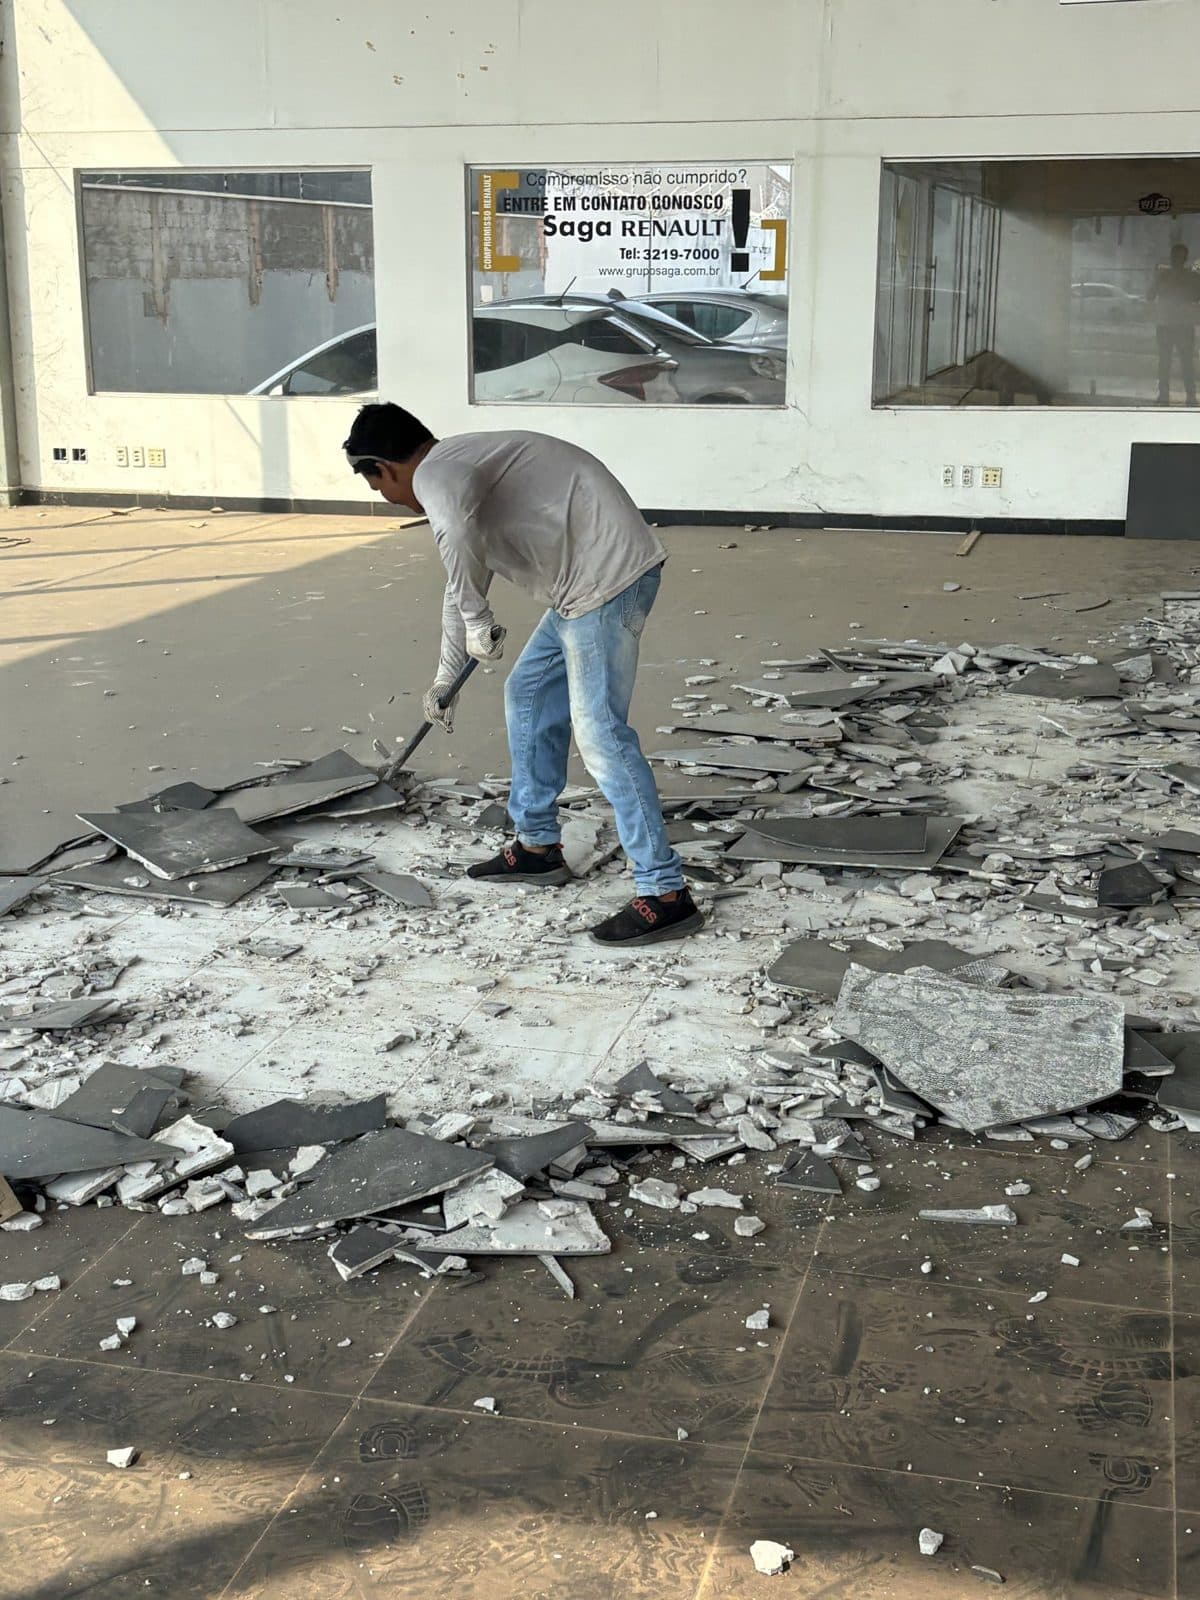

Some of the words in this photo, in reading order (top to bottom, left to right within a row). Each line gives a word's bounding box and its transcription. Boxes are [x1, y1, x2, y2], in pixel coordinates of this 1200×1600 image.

[526, 171, 629, 187] Compromisso
[634, 171, 661, 185] não
[667, 169, 747, 186] cumprido?
[483, 174, 492, 209] RENAULT
[503, 196, 549, 212] ENTRE
[554, 196, 576, 211] EM
[581, 195, 646, 211] CONTATO
[652, 194, 723, 210] CONOSCO
[543, 215, 612, 242] Saga
[622, 219, 725, 237] RENAULT
[483, 210, 492, 270] COMPROMISSO
[619, 247, 640, 260] Tel:
[643, 249, 719, 260] 3219-7000
[598, 266, 720, 278] www.gruposaga.com.br
